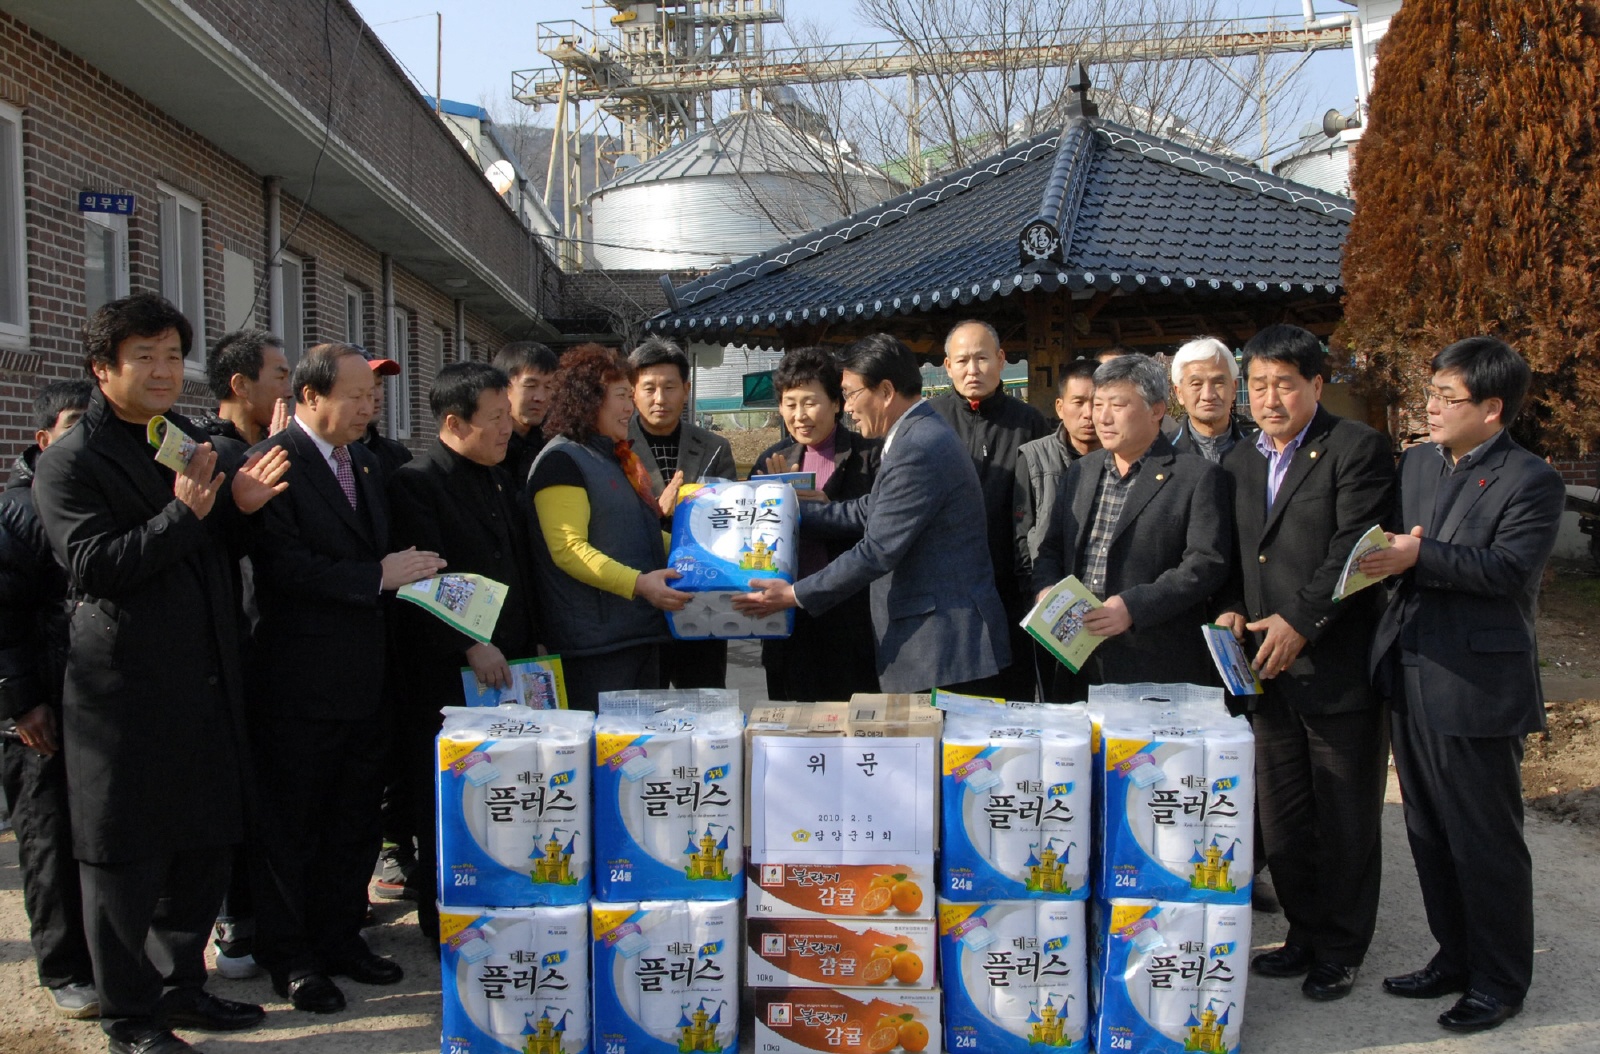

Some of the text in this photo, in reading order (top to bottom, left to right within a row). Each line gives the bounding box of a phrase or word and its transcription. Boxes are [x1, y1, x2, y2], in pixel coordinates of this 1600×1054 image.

[84, 196, 128, 211] 의무실
[1029, 227, 1049, 248] 福
[708, 507, 781, 529] 플러스
[517, 771, 546, 785] 데코
[672, 766, 700, 779] 데코
[1180, 775, 1208, 789] 데코
[1016, 780, 1044, 794] 데코
[485, 786, 577, 822] 플러스
[640, 781, 731, 817] 플러스
[1147, 789, 1238, 825] 플러스
[984, 794, 1074, 829] 플러스
[818, 887, 857, 906] 감귤
[755, 905, 773, 913] 10kg
[667, 942, 695, 955] 데코
[1012, 936, 1040, 950] 데코
[1179, 940, 1206, 954] 데코
[510, 950, 538, 964] 데코
[819, 957, 857, 976] 감귤
[635, 957, 724, 992] 플러스
[756, 974, 774, 982] 10kg
[982, 951, 1071, 987] 플러스
[1146, 955, 1235, 989] 플러스
[478, 965, 569, 999] 플러스
[824, 1027, 863, 1046] 감귤
[763, 1043, 780, 1052] 10kg
